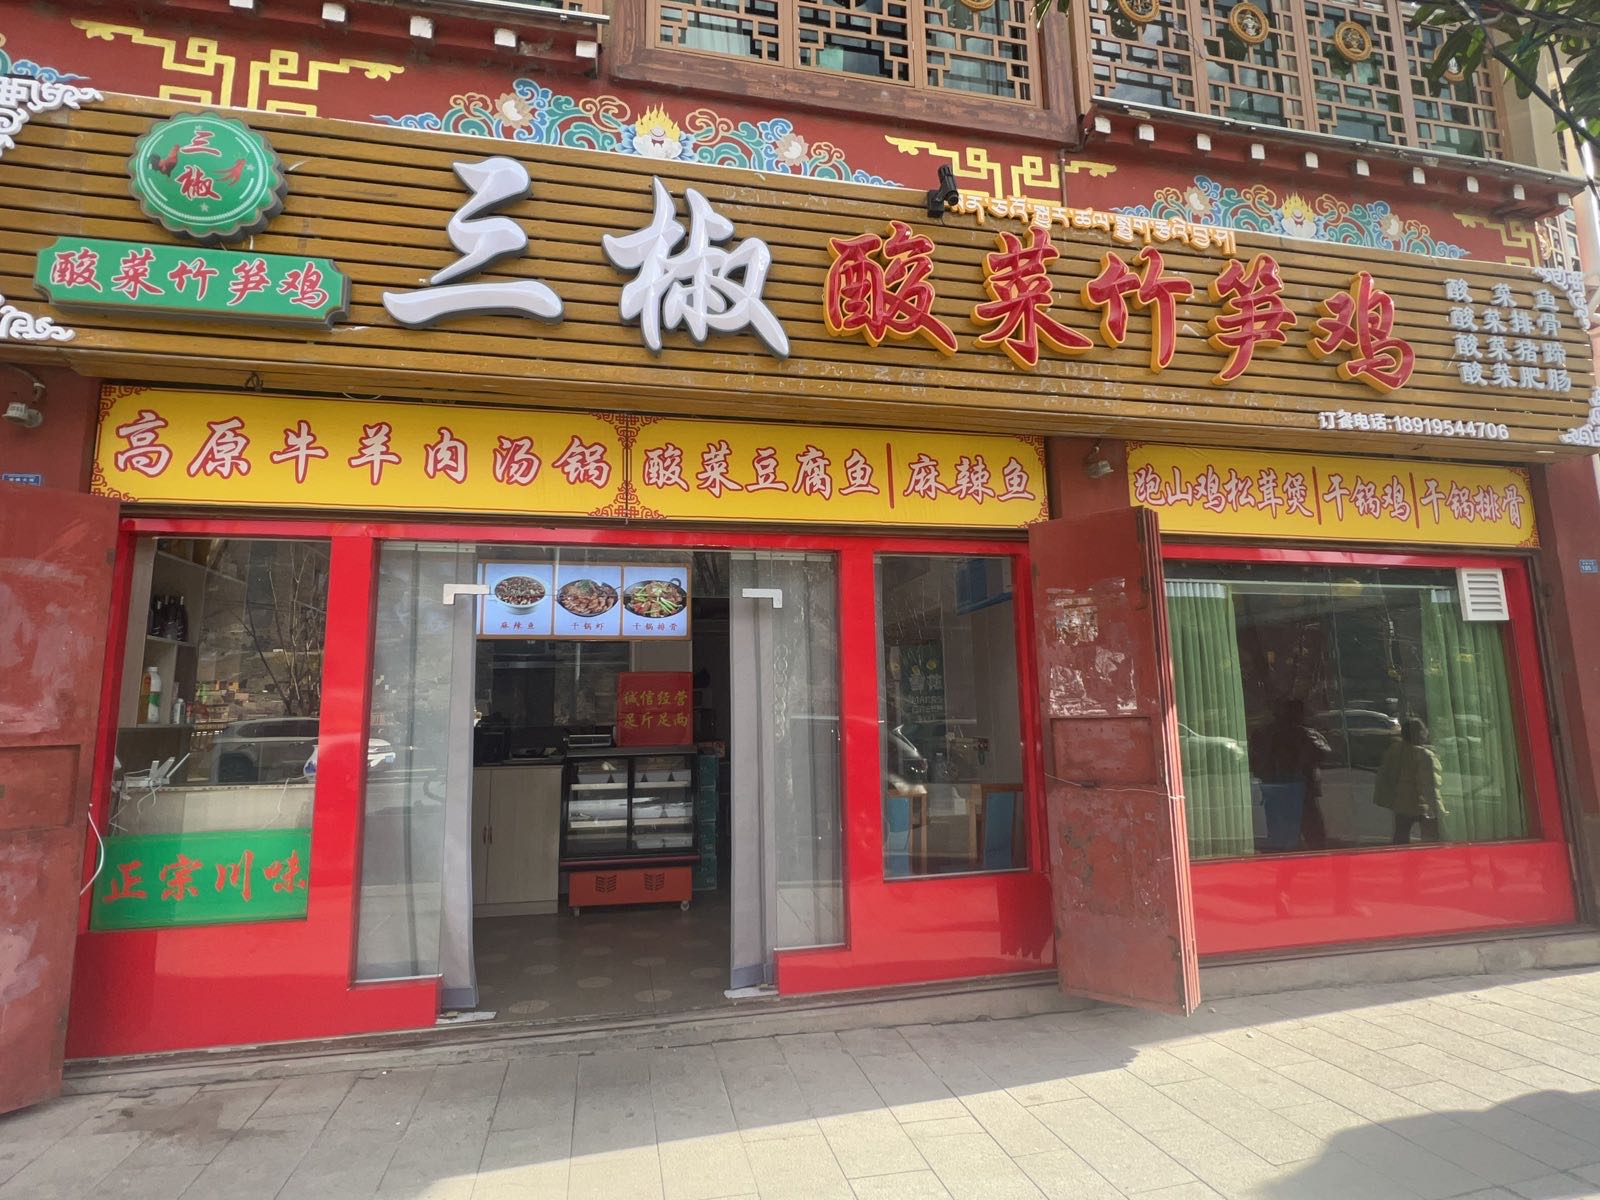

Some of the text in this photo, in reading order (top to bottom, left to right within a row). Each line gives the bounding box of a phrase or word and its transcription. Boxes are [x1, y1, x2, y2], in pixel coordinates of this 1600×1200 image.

[176, 130, 222, 201] 三椒
[49, 246, 330, 310] 酸菜竹笋鸡
[1444, 278, 1559, 313] 酸菜鱼
[823, 219, 1415, 394] 酸菜竹笋鸡
[1449, 306, 1561, 336] 酸菜排骨
[1452, 333, 1567, 365] 酸菜猪蹄
[1457, 361, 1572, 392] 酸菜肥肠
[115, 409, 612, 488] 高原牛羊肉汤锅
[643, 440, 1036, 505] 酸菜豆腐鱼 麻辣鱼
[1134, 463, 1525, 529] 跑山鸡松茸煲 干锅鸡 干锅排骨
[501, 621, 535, 631] 麻辣鱼
[570, 622, 604, 631] 干锅虾
[632, 622, 678, 631] 干锅排骨
[103, 849, 306, 903] 正宗川味
